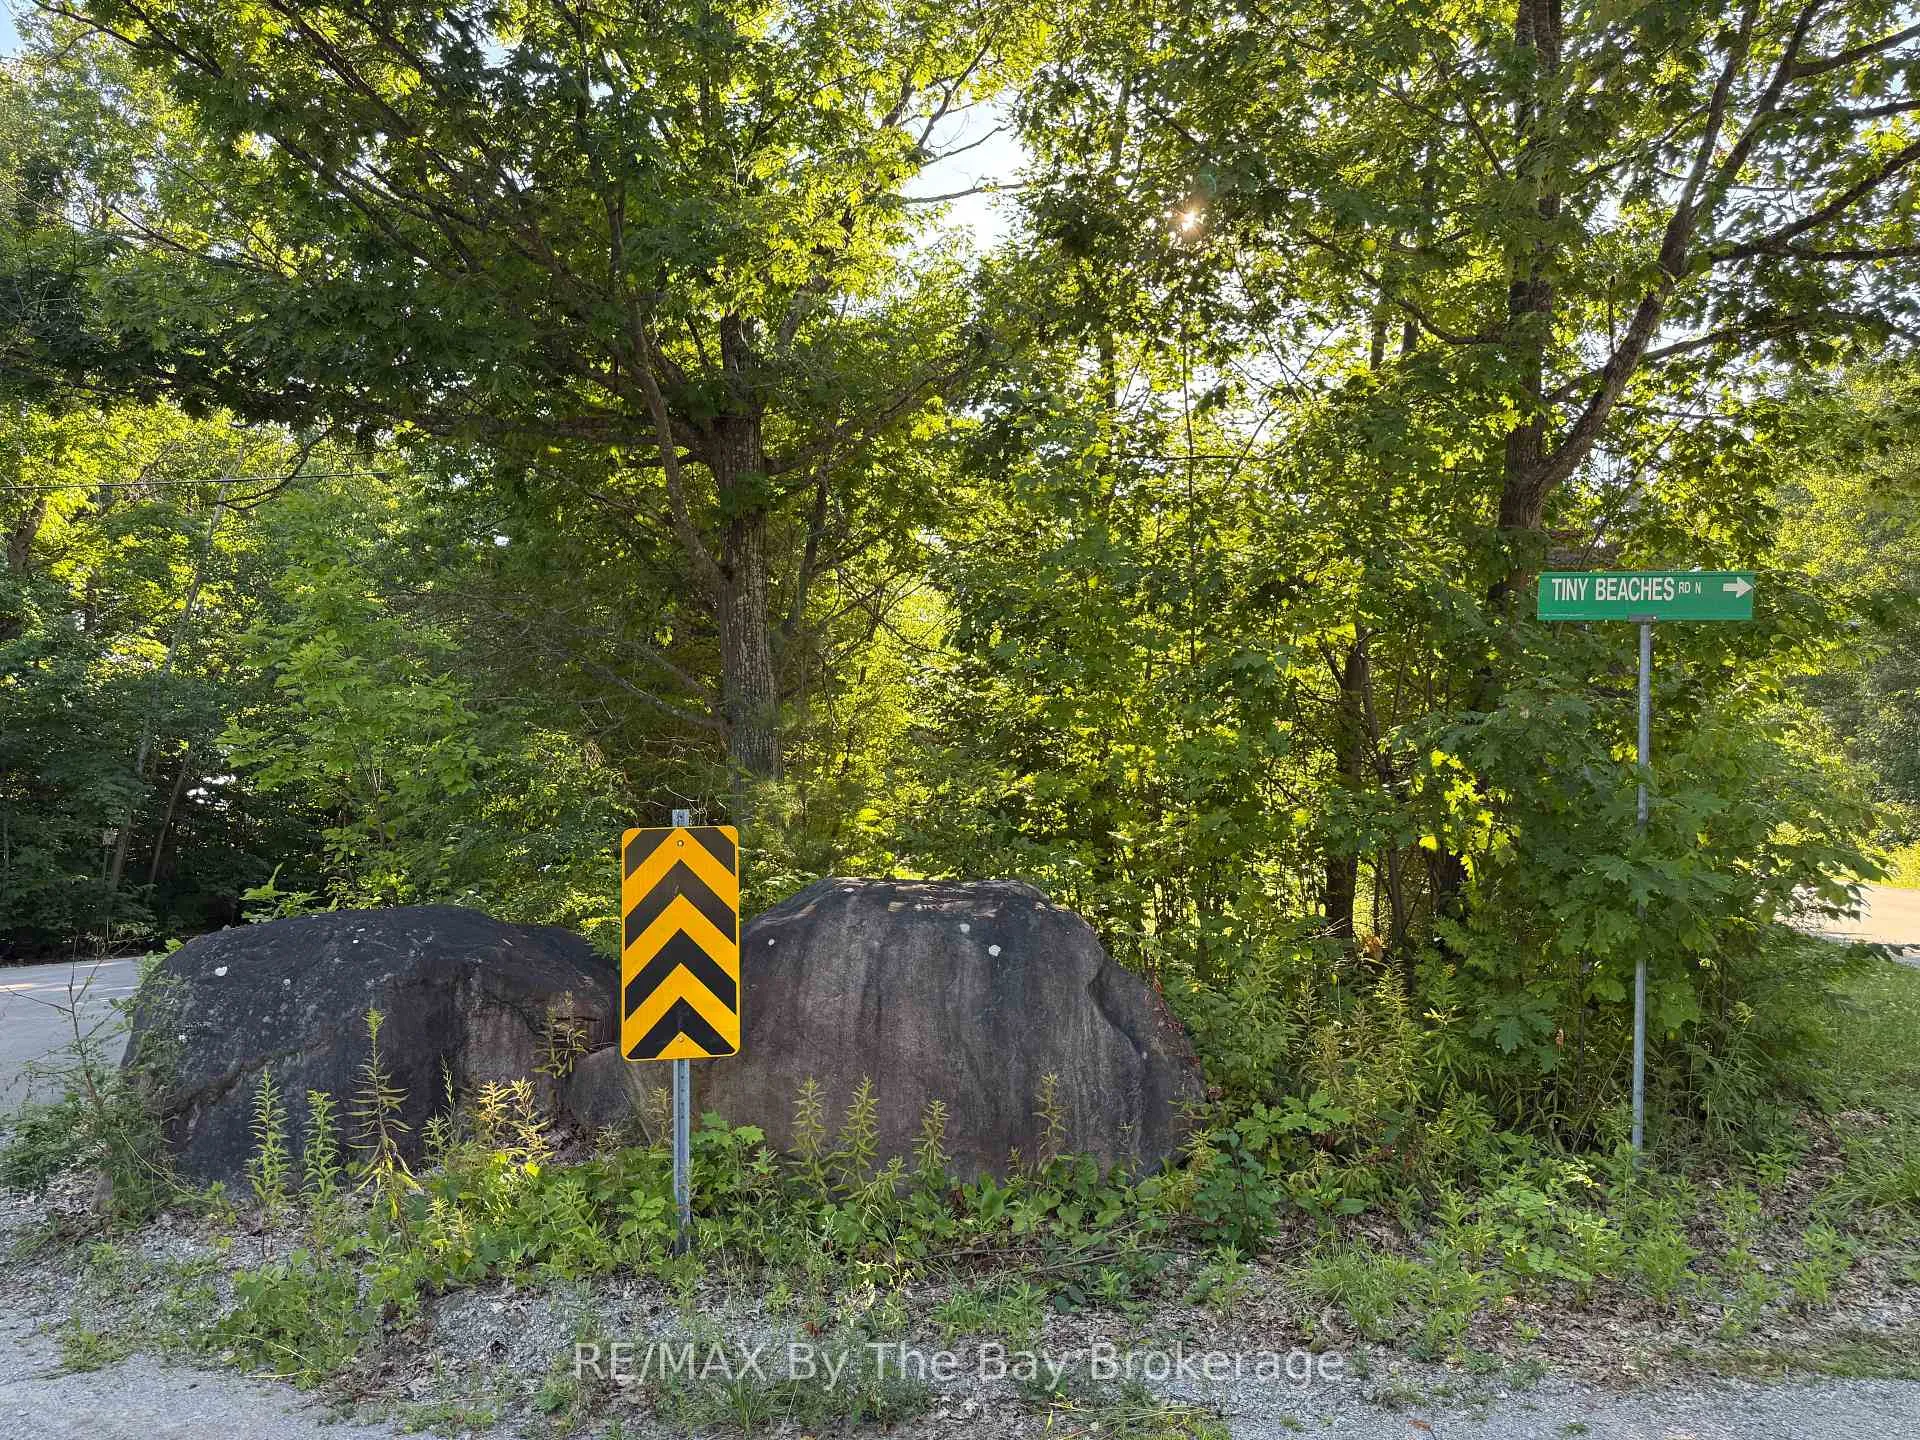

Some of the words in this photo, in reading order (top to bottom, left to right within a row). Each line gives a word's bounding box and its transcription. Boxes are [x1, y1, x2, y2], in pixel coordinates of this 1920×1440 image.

[1552, 578, 1589, 601] TINY
[1595, 577, 1675, 601] BEACHES
[1678, 581, 1691, 593] RD
[1695, 581, 1702, 595] N
